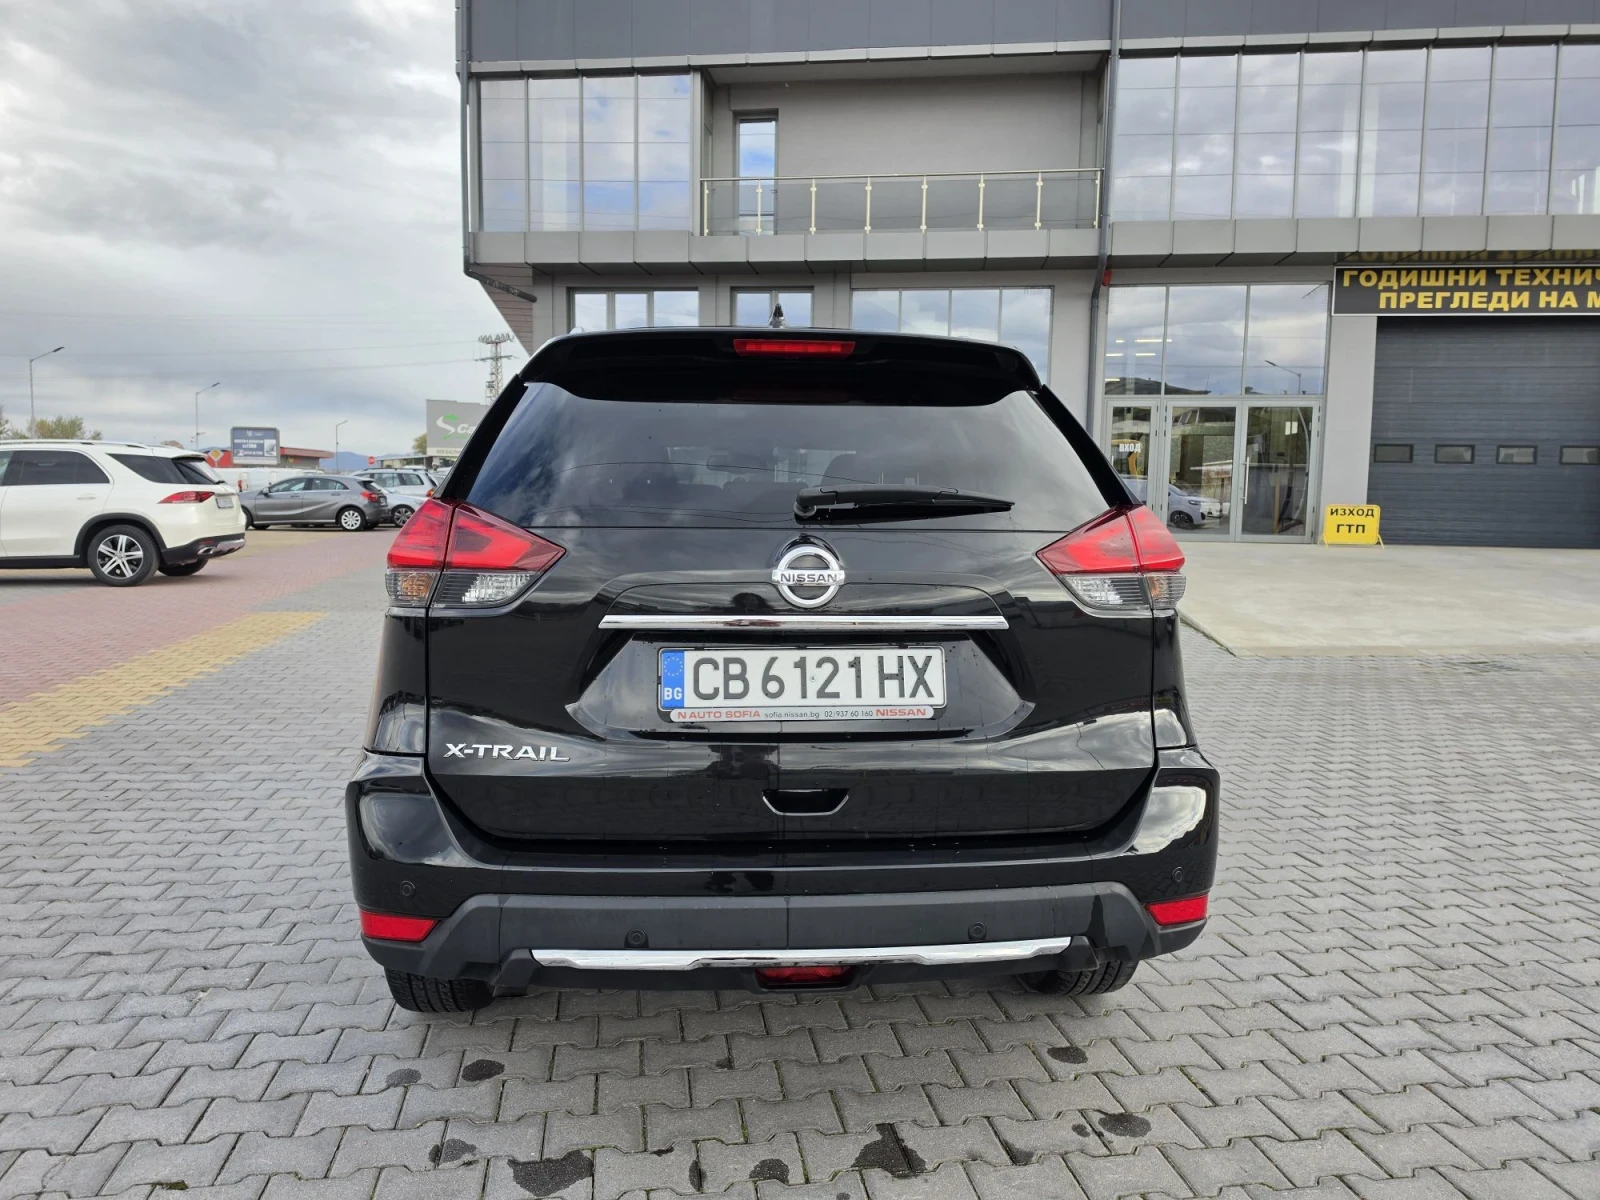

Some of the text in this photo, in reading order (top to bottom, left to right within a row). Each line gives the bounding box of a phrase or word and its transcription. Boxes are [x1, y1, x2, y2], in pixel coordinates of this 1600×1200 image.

[1343, 268, 1600, 290] ГОДИШНИ ТЕХНИ
[1379, 291, 1530, 312] ПРЕГЛЕДИ
[1539, 291, 1579, 308] НА
[1119, 443, 1141, 453] ВХОД
[1330, 508, 1375, 518] ИЗХОД
[1336, 524, 1366, 533] ГТП
[780, 573, 837, 583] NISSAN
[693, 655, 935, 700] CB 6121 HX
[664, 687, 682, 700] BG
[677, 711, 687, 719] N
[689, 711, 722, 719] AUTO
[725, 710, 761, 719] SOFIA
[876, 708, 926, 717] NISSAN
[443, 742, 571, 762] X-TRAIL
